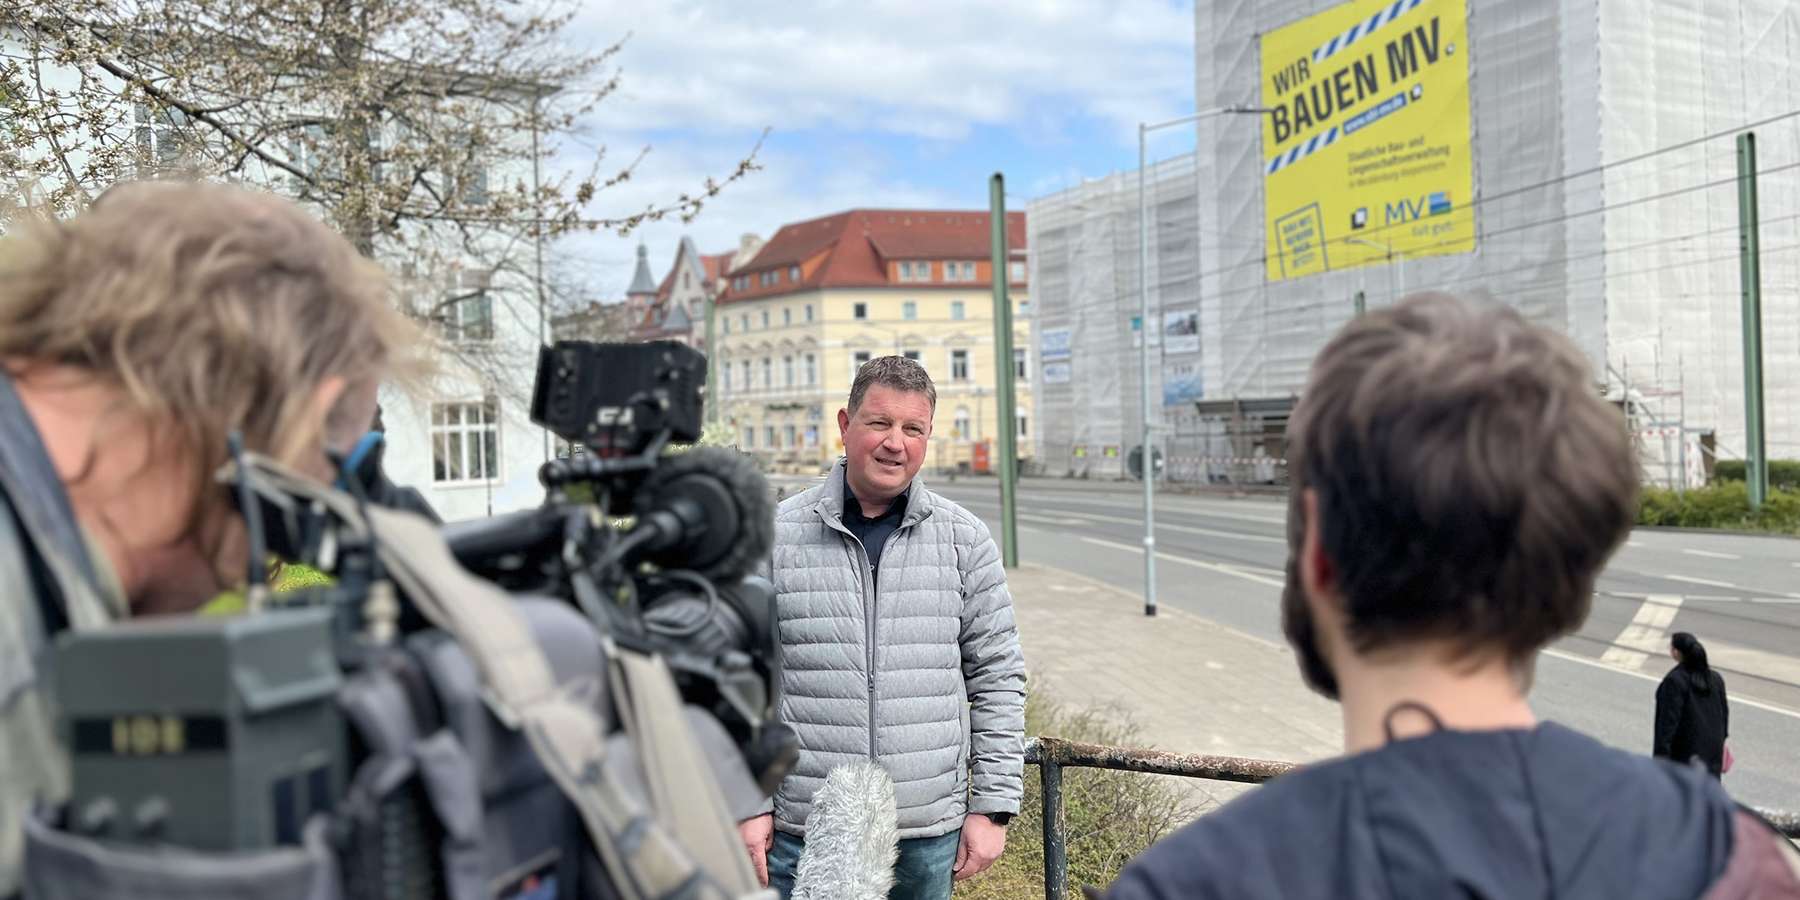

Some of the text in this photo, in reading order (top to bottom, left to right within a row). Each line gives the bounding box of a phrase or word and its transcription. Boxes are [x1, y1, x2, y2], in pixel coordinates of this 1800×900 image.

[1272, 57, 1311, 96] WIR
[1272, 54, 1378, 144] BAUEN
[1386, 194, 1425, 225] MV
